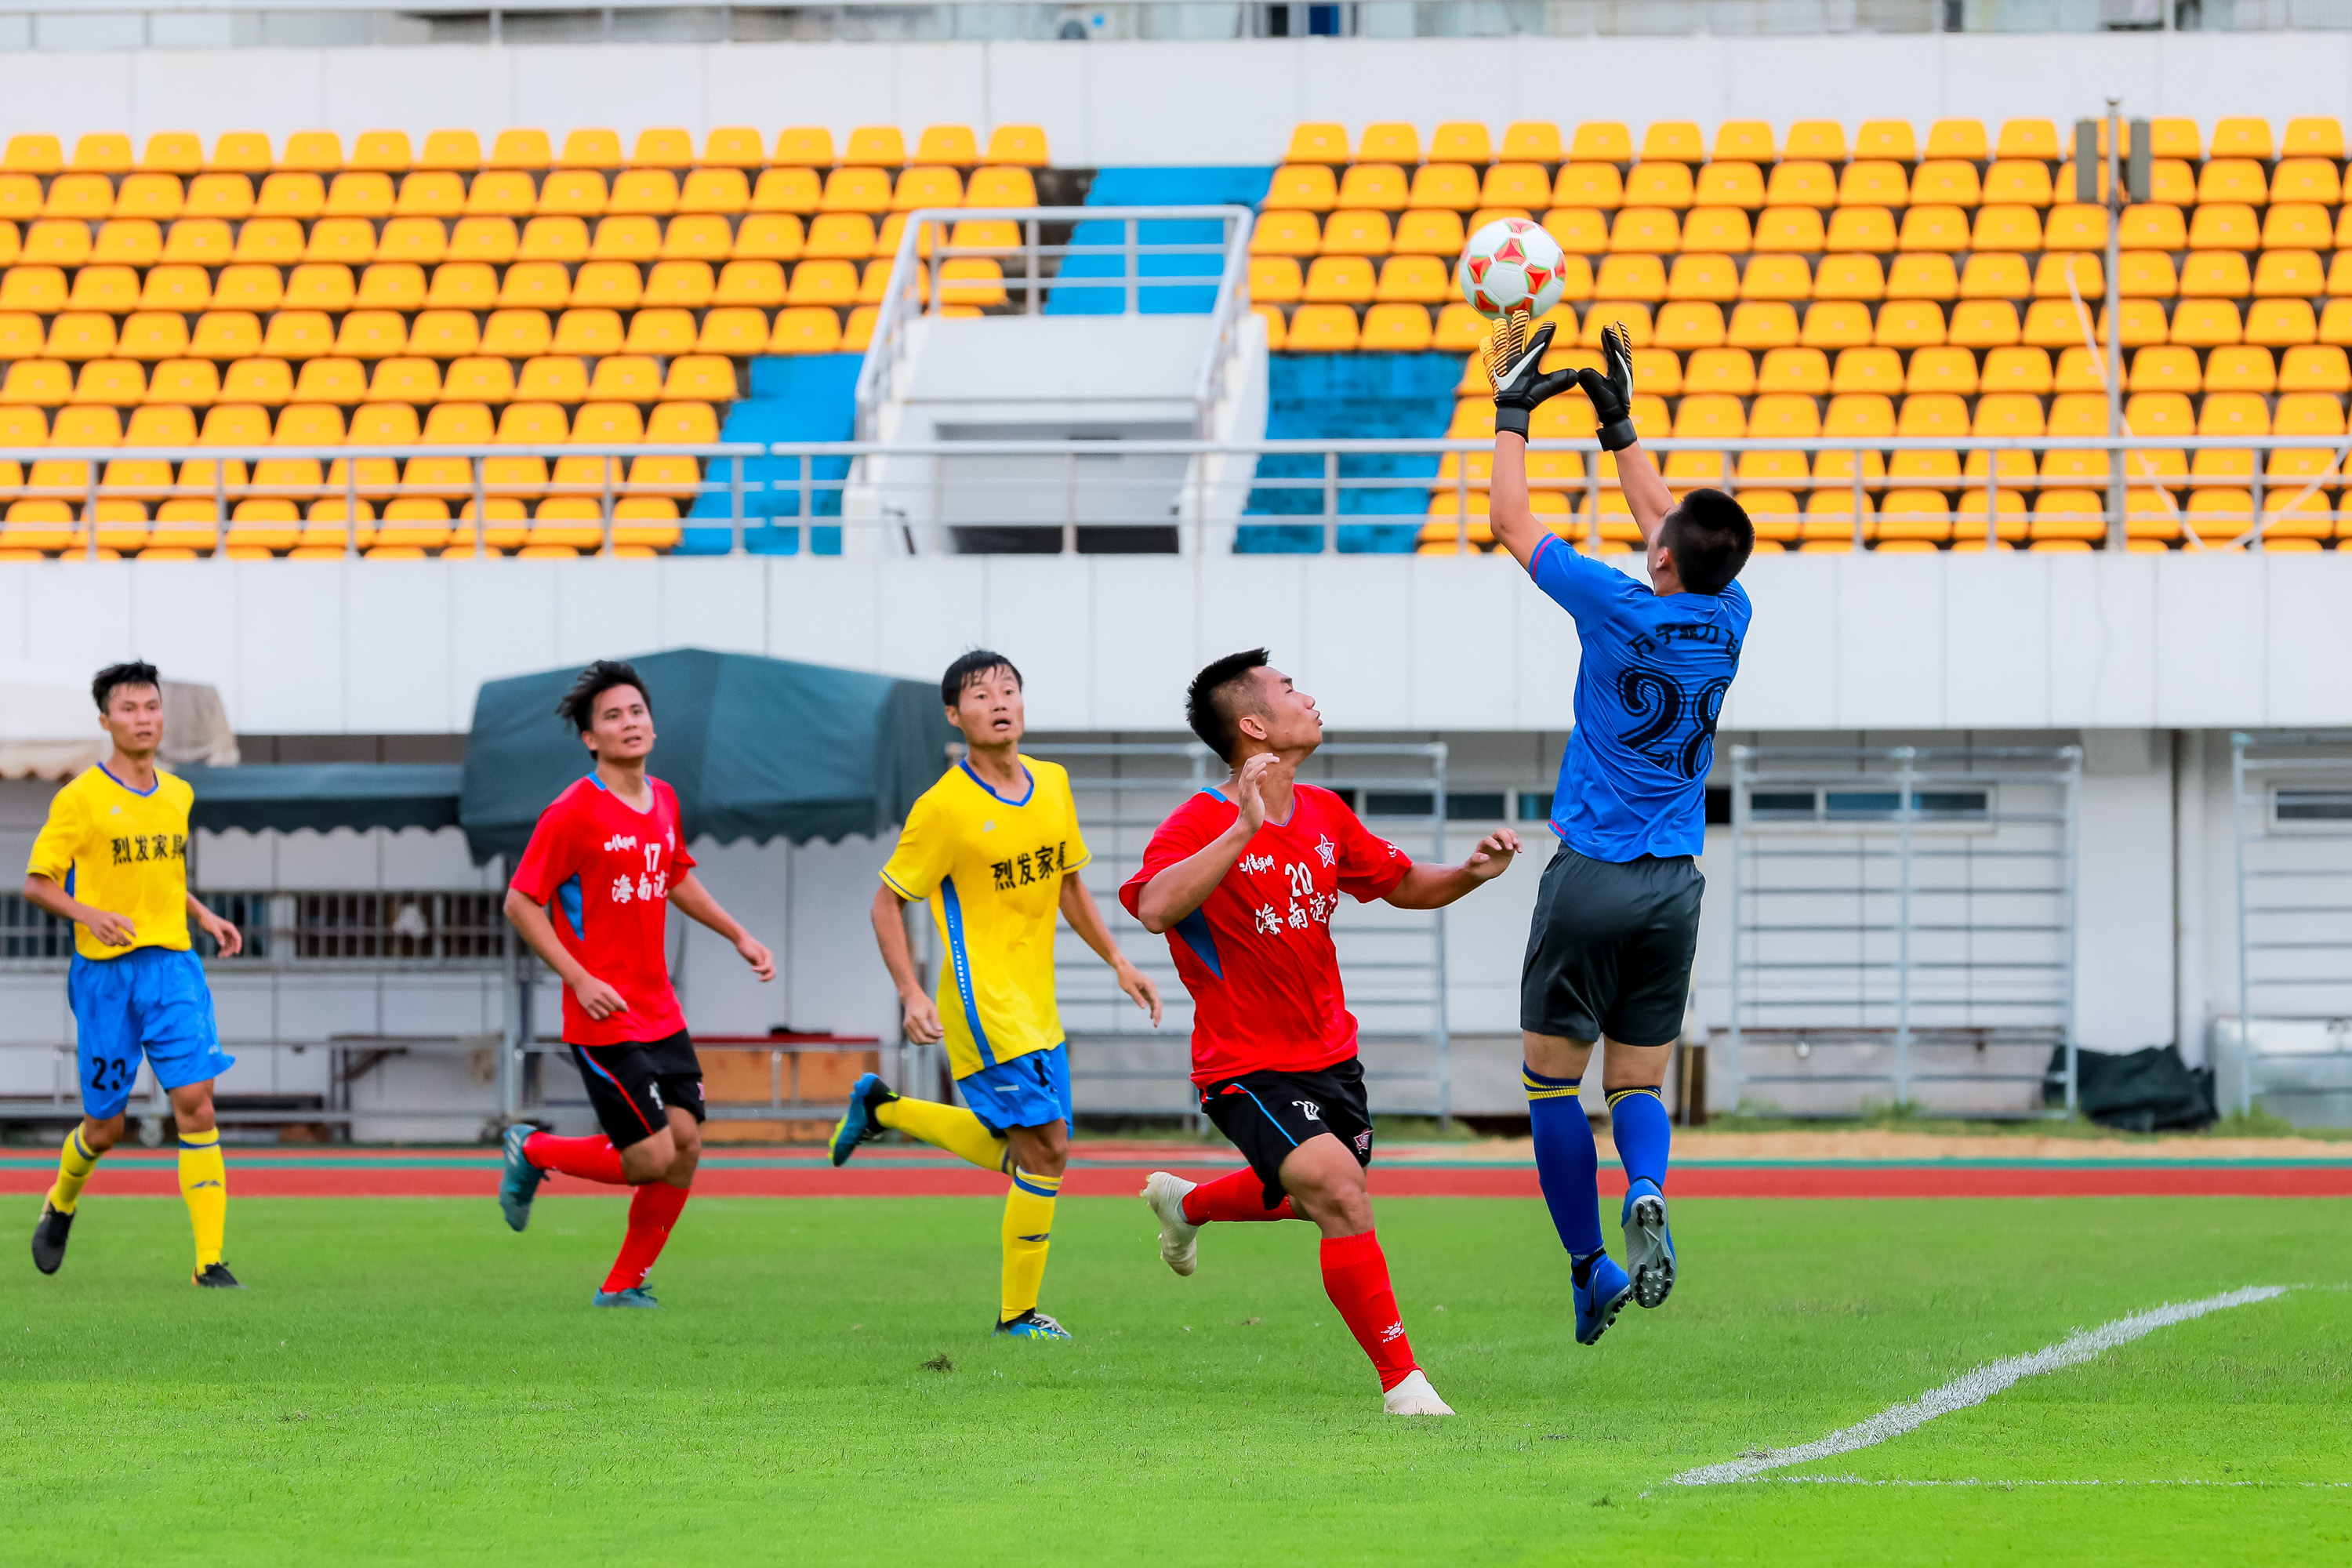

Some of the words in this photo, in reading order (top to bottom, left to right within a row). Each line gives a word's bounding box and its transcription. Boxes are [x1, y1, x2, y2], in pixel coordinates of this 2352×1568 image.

[1617, 667, 1733, 780] 28
[644, 843, 661, 872] 17
[1285, 862, 1313, 897] 20
[92, 1057, 125, 1091] 23
